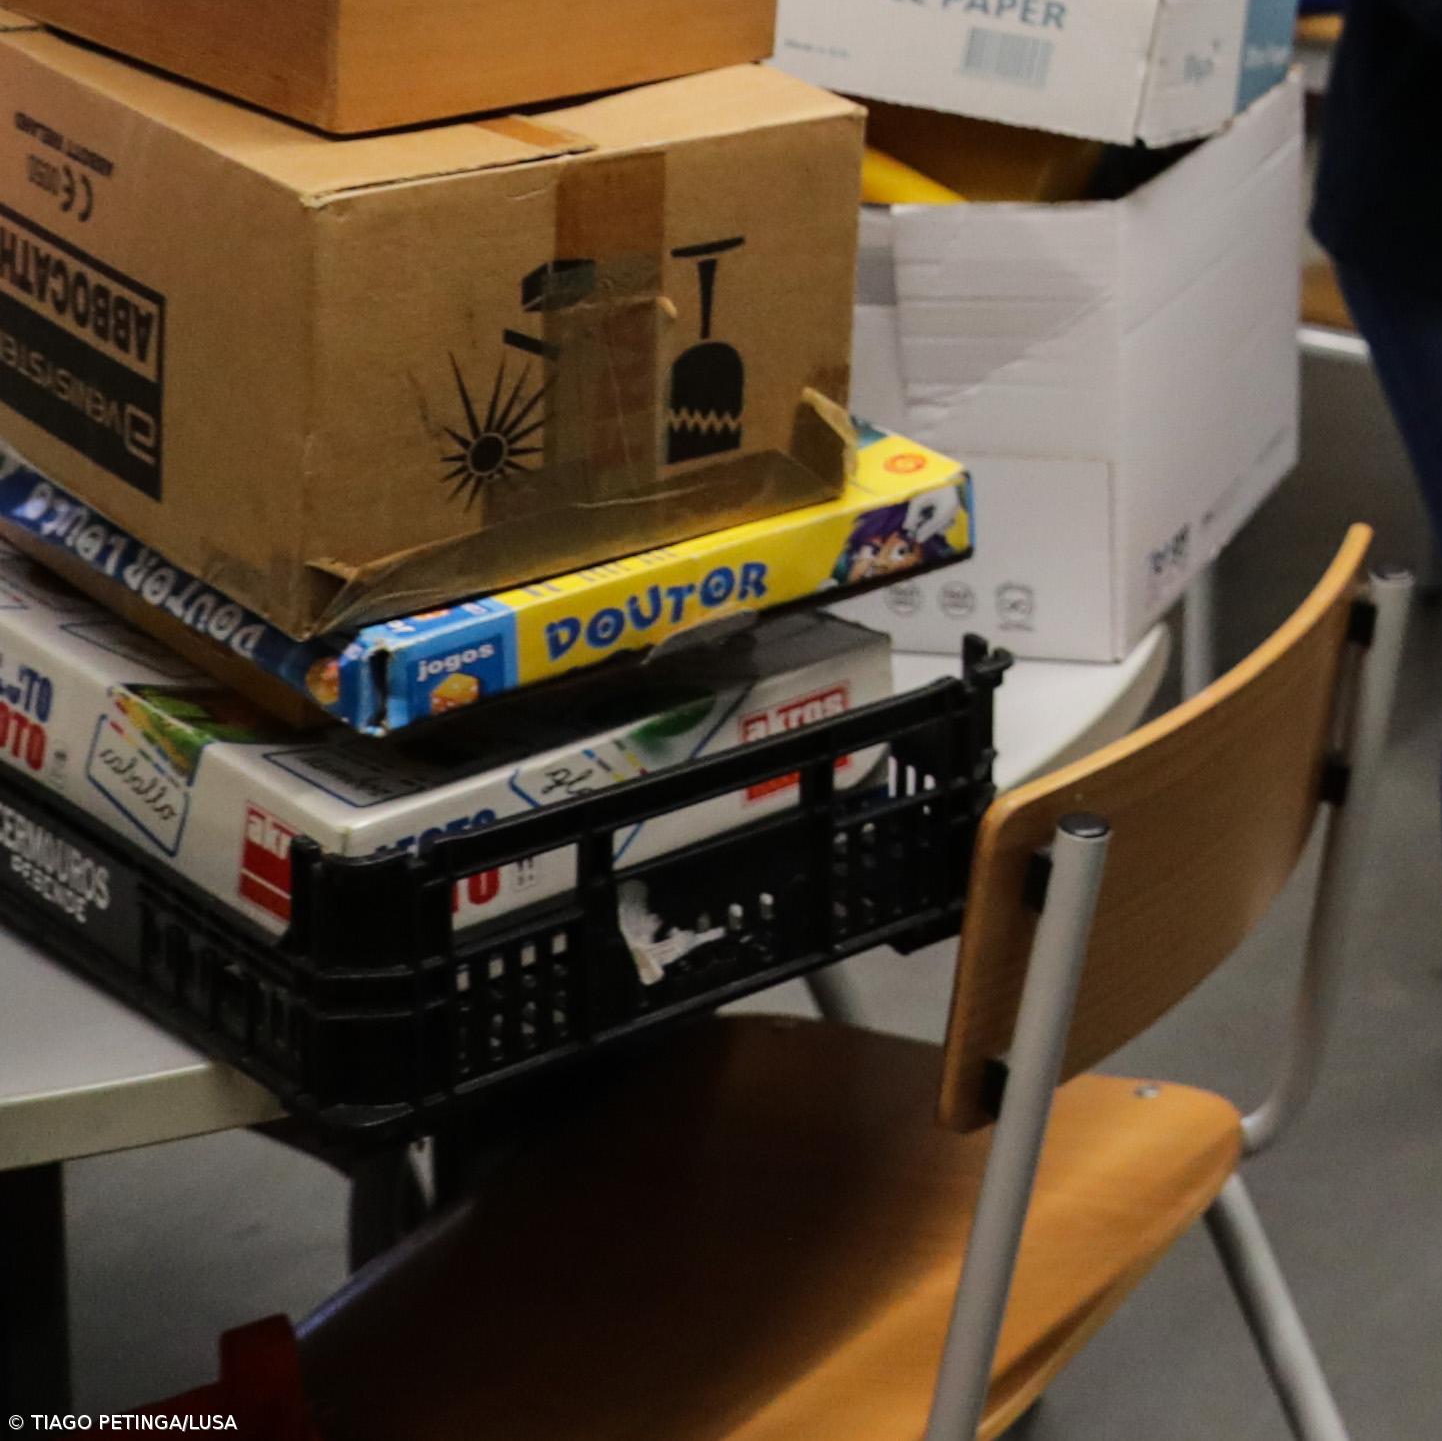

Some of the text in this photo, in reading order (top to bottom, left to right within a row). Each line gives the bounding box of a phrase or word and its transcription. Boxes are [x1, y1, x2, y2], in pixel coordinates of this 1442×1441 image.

[122, 544, 269, 659] DOUTOR
[545, 561, 770, 662] DOUTOR
[416, 644, 496, 682] jogos
